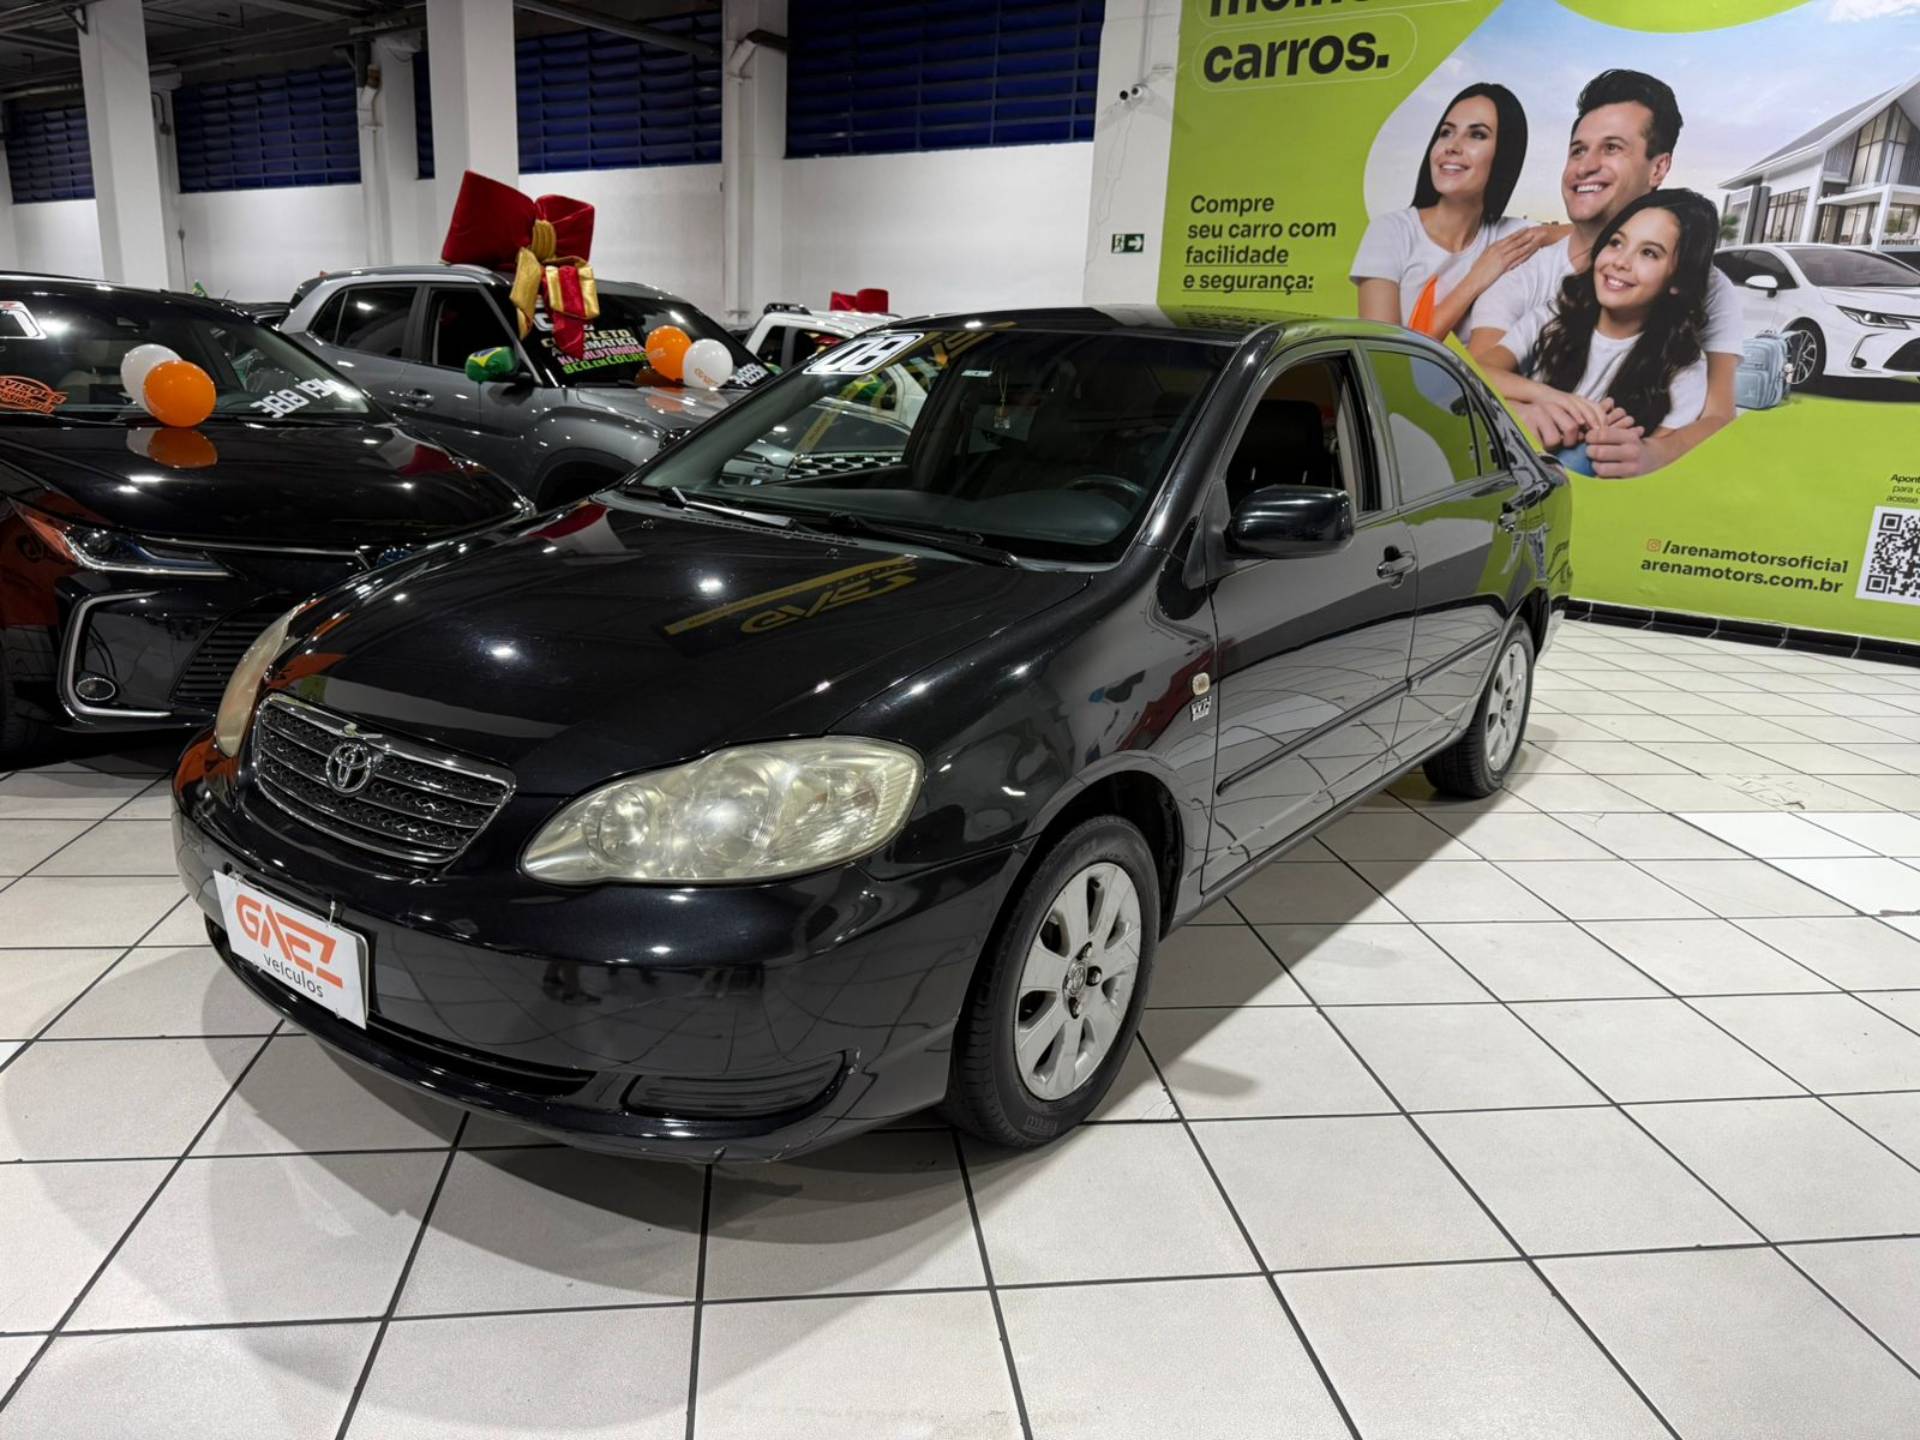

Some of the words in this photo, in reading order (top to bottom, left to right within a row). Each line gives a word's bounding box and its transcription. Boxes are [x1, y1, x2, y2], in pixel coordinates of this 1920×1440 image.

[1203, 32, 1390, 83] carros.
[1191, 195, 1275, 217] Compre
[1187, 223, 1223, 239] seu
[1228, 222, 1283, 238] carro
[1288, 221, 1337, 237] com
[1185, 245, 1289, 264] facilidade
[1183, 274, 1195, 289] e
[1200, 274, 1314, 295] segurança:
[805, 334, 922, 374] 08
[1662, 540, 1849, 573] /arenamotorsoficial
[1641, 559, 1843, 593] arenamotors.com.br
